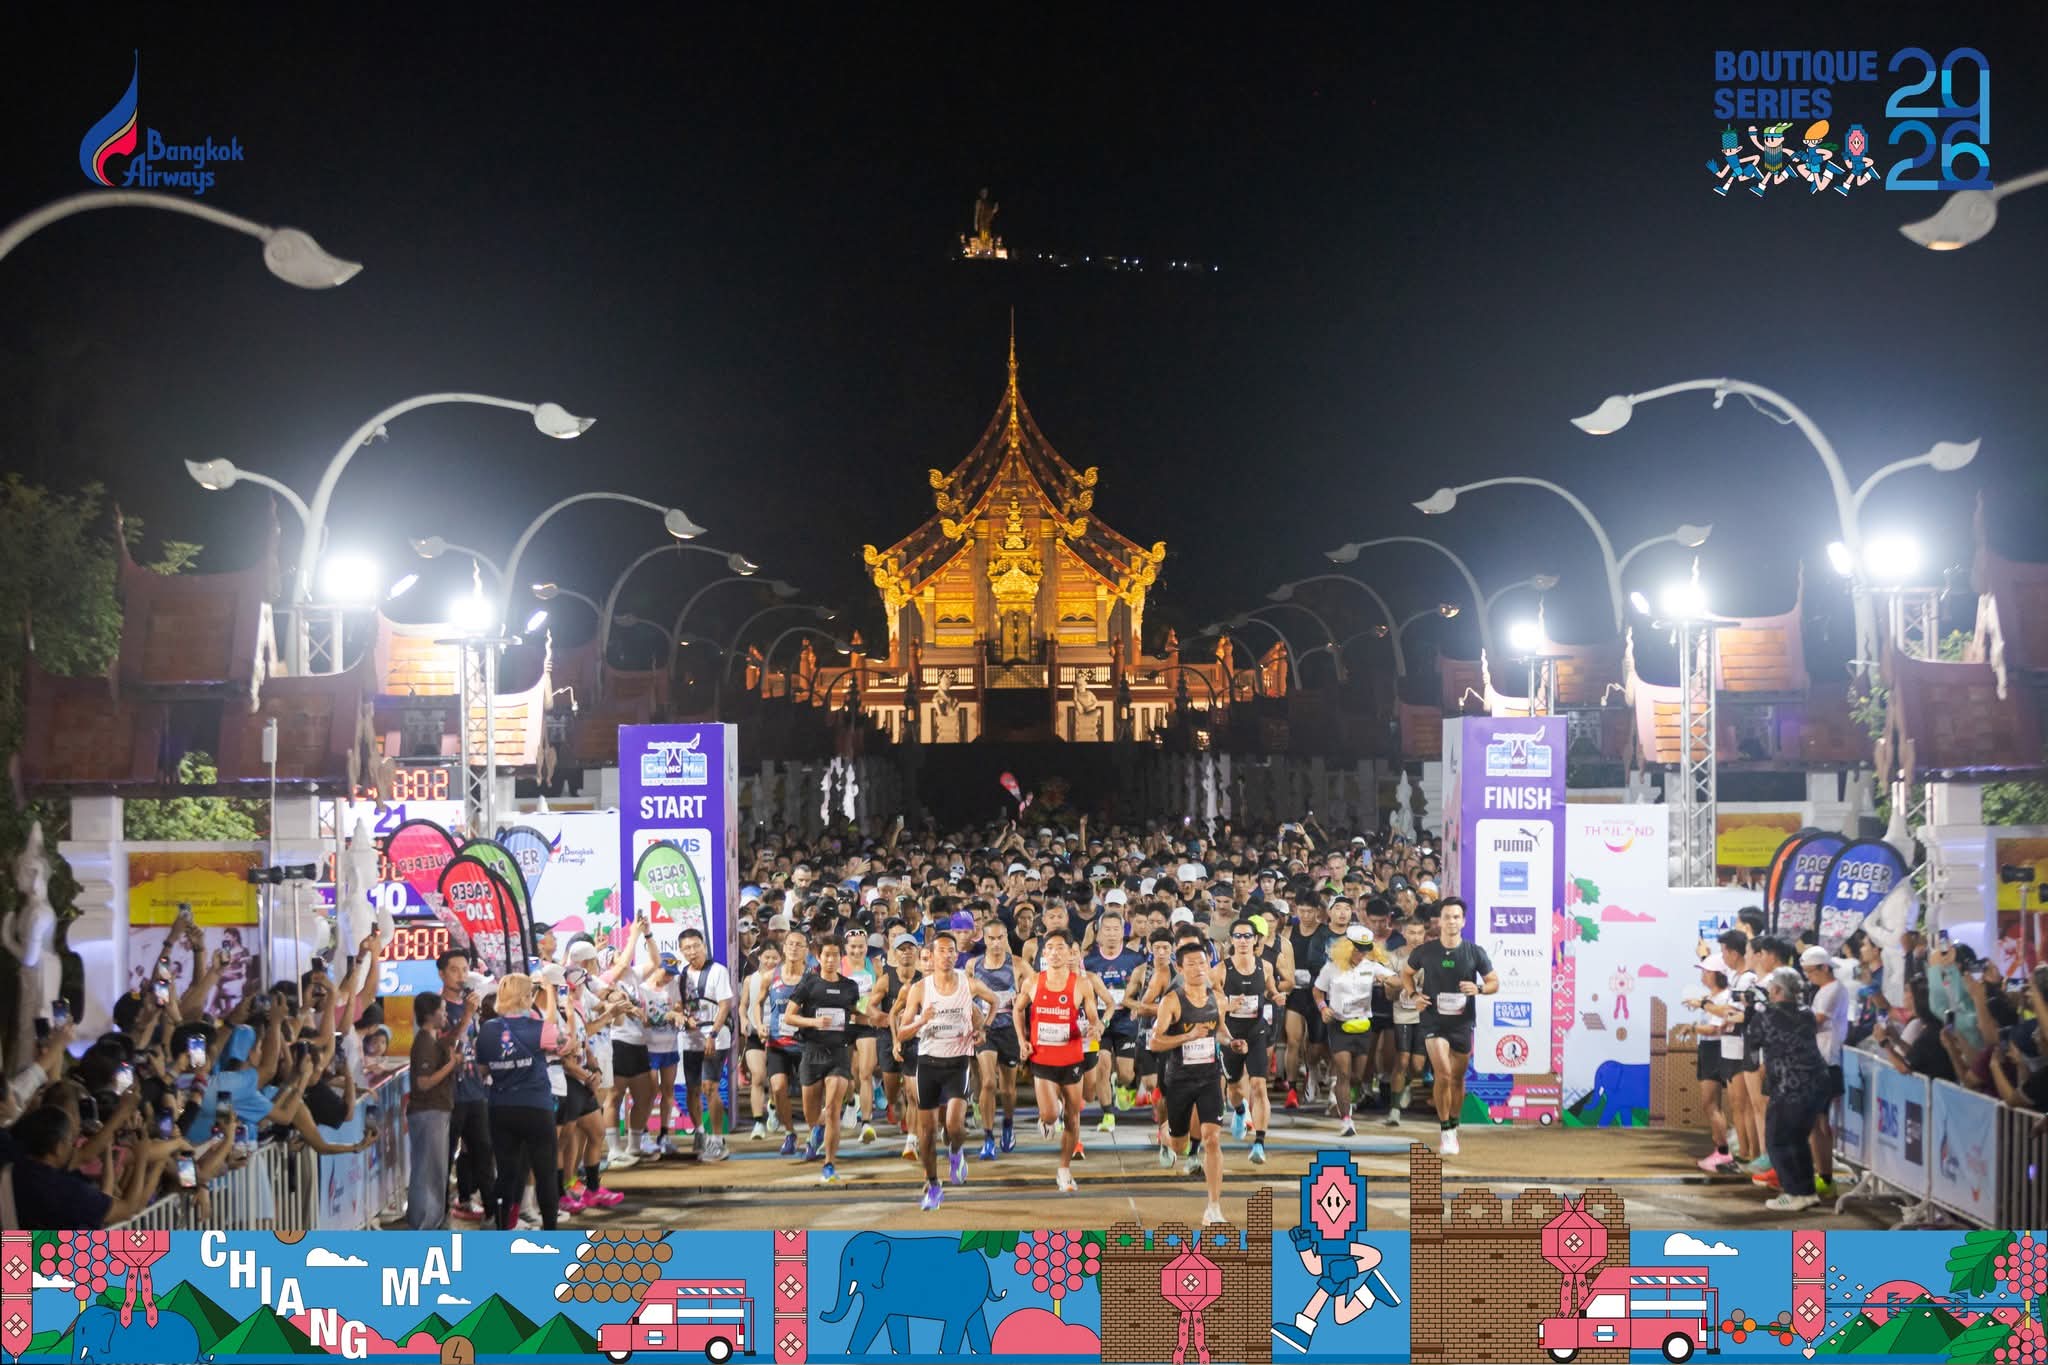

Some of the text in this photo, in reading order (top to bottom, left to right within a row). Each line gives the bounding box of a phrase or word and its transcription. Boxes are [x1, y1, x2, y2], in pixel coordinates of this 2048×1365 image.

[640, 796, 707, 819] START
[1484, 786, 1552, 810] FINISH
[373, 804, 406, 833] 21
[564, 846, 594, 857] Bangkok
[1494, 839, 1533, 852] PUMA
[1797, 856, 1833, 873] PAC
[1838, 861, 1892, 883] PACER
[369, 882, 407, 915] 10
[1837, 880, 1870, 901] 2.15
[1509, 914, 1533, 924] KKP
[1504, 949, 1543, 957] PRIMUS
[378, 961, 400, 993] 5
